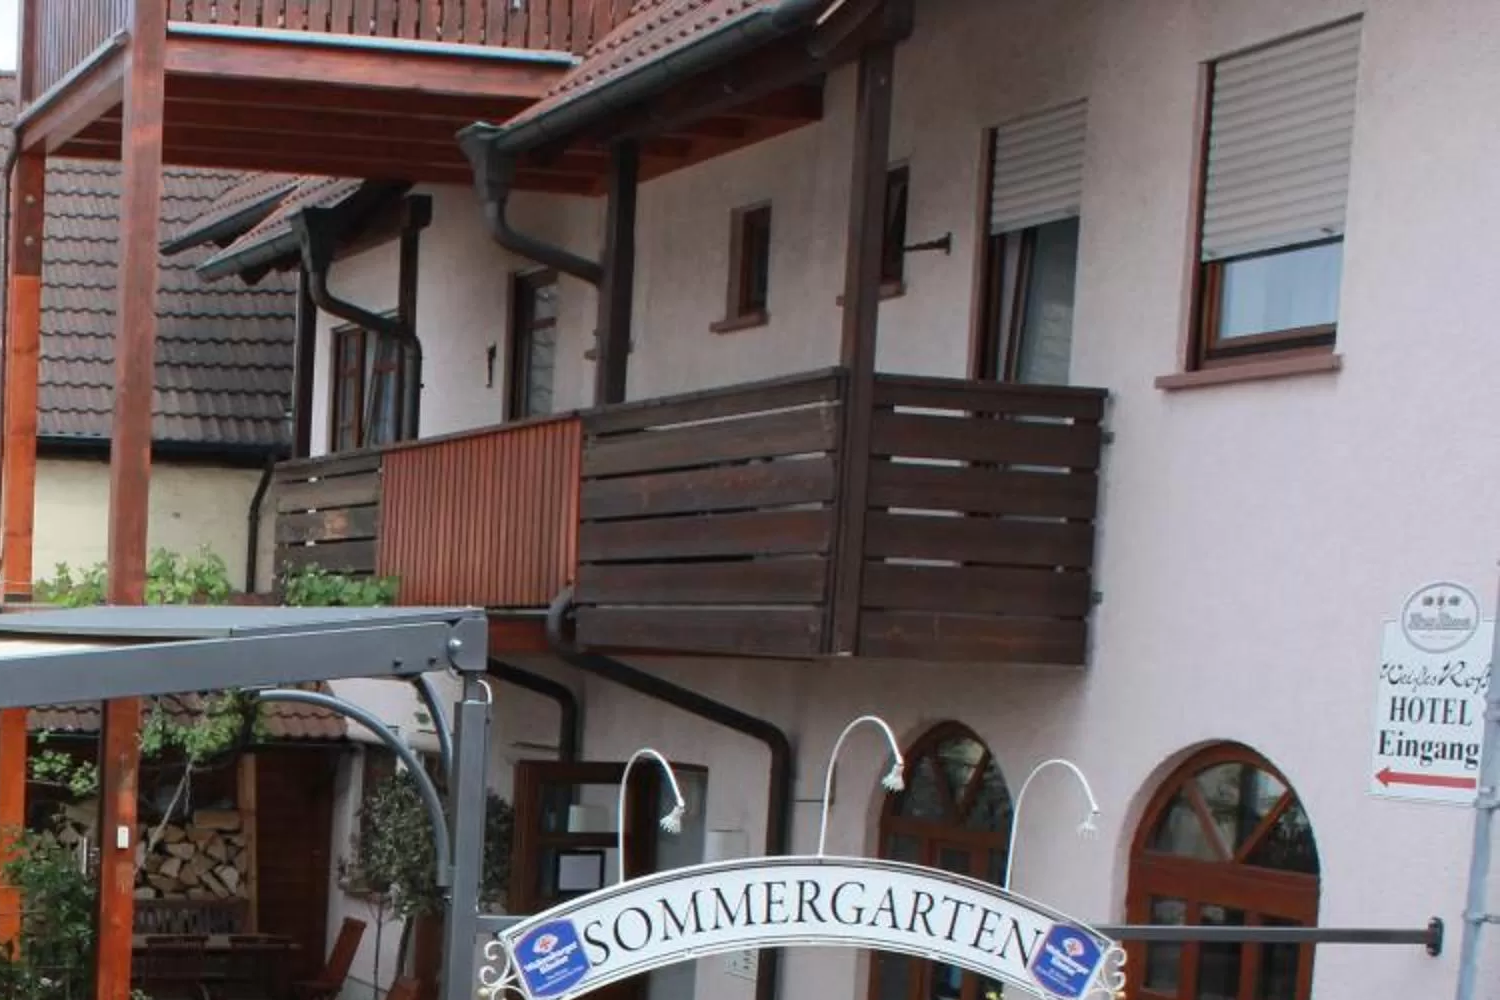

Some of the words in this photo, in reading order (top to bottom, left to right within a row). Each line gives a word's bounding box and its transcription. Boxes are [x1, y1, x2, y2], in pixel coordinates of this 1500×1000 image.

[1389, 696, 1472, 726] HOTEL
[1378, 729, 1480, 770] Eingang
[583, 879, 1045, 968] SOMMERGARTEN
